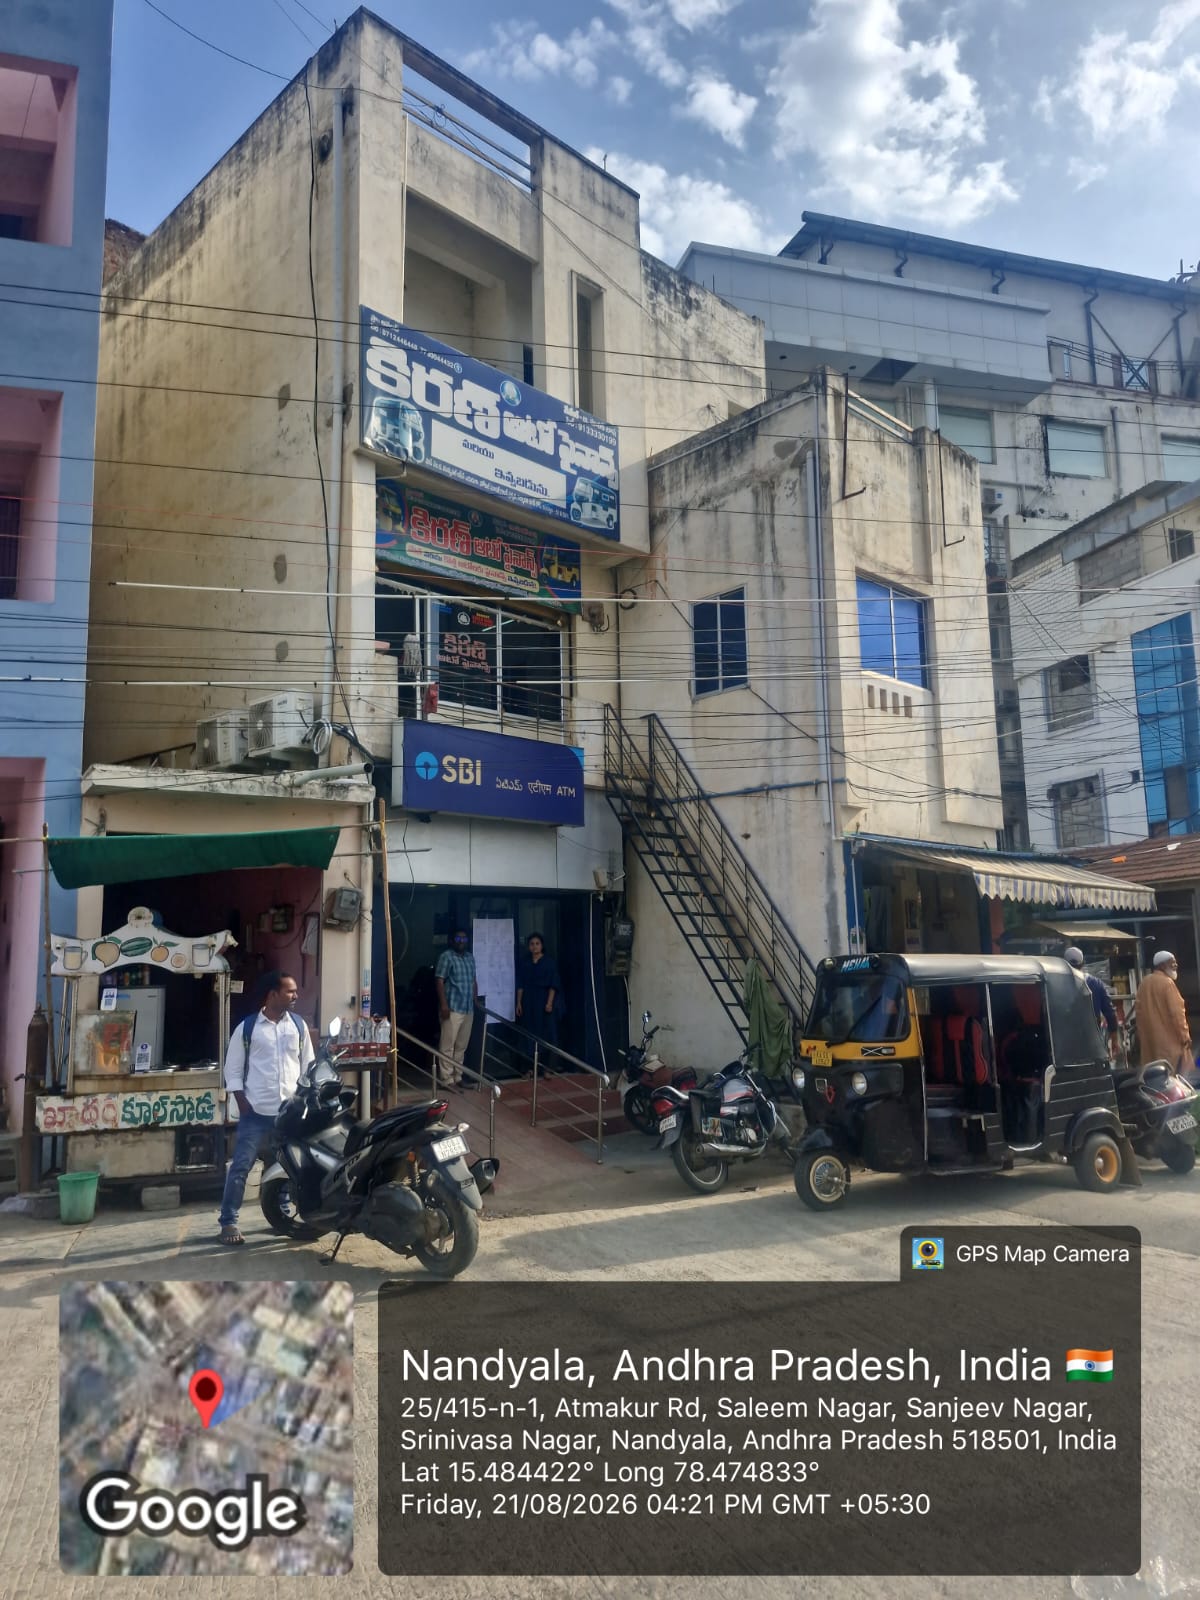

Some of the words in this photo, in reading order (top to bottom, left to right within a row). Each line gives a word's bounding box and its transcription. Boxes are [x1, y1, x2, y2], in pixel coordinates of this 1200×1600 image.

[410, 506, 472, 556] కిరణ్
[441, 754, 482, 786] SBI
[527, 779, 552, 795] एटीएम
[556, 785, 576, 798] ATM
